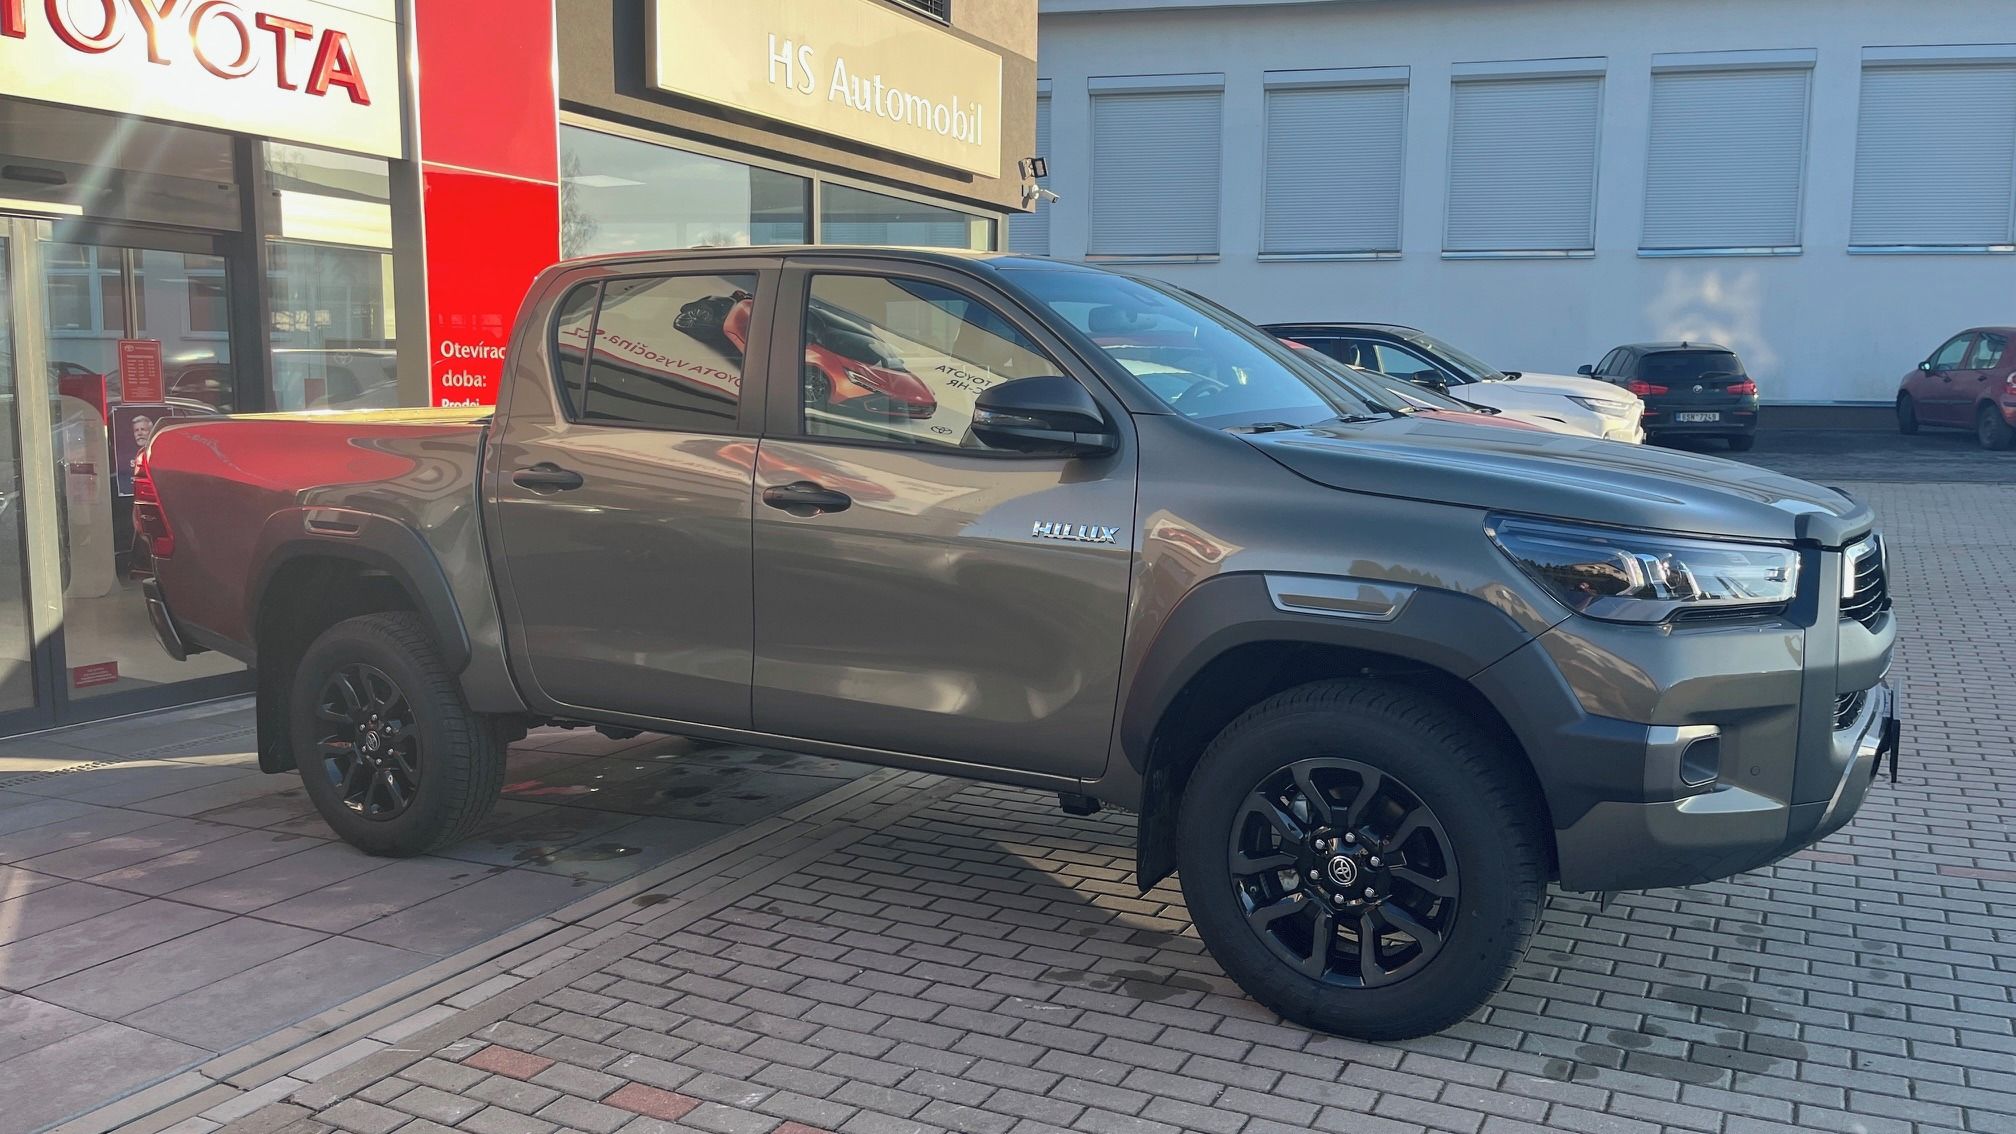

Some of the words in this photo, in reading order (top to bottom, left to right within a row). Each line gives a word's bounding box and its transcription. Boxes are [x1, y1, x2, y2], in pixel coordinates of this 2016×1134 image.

[768, 33, 815, 95] HS
[828, 57, 982, 145] Automobil
[440, 340, 506, 360] Otevírac
[441, 369, 487, 387] doba:
[1032, 520, 1120, 544] HILUX
